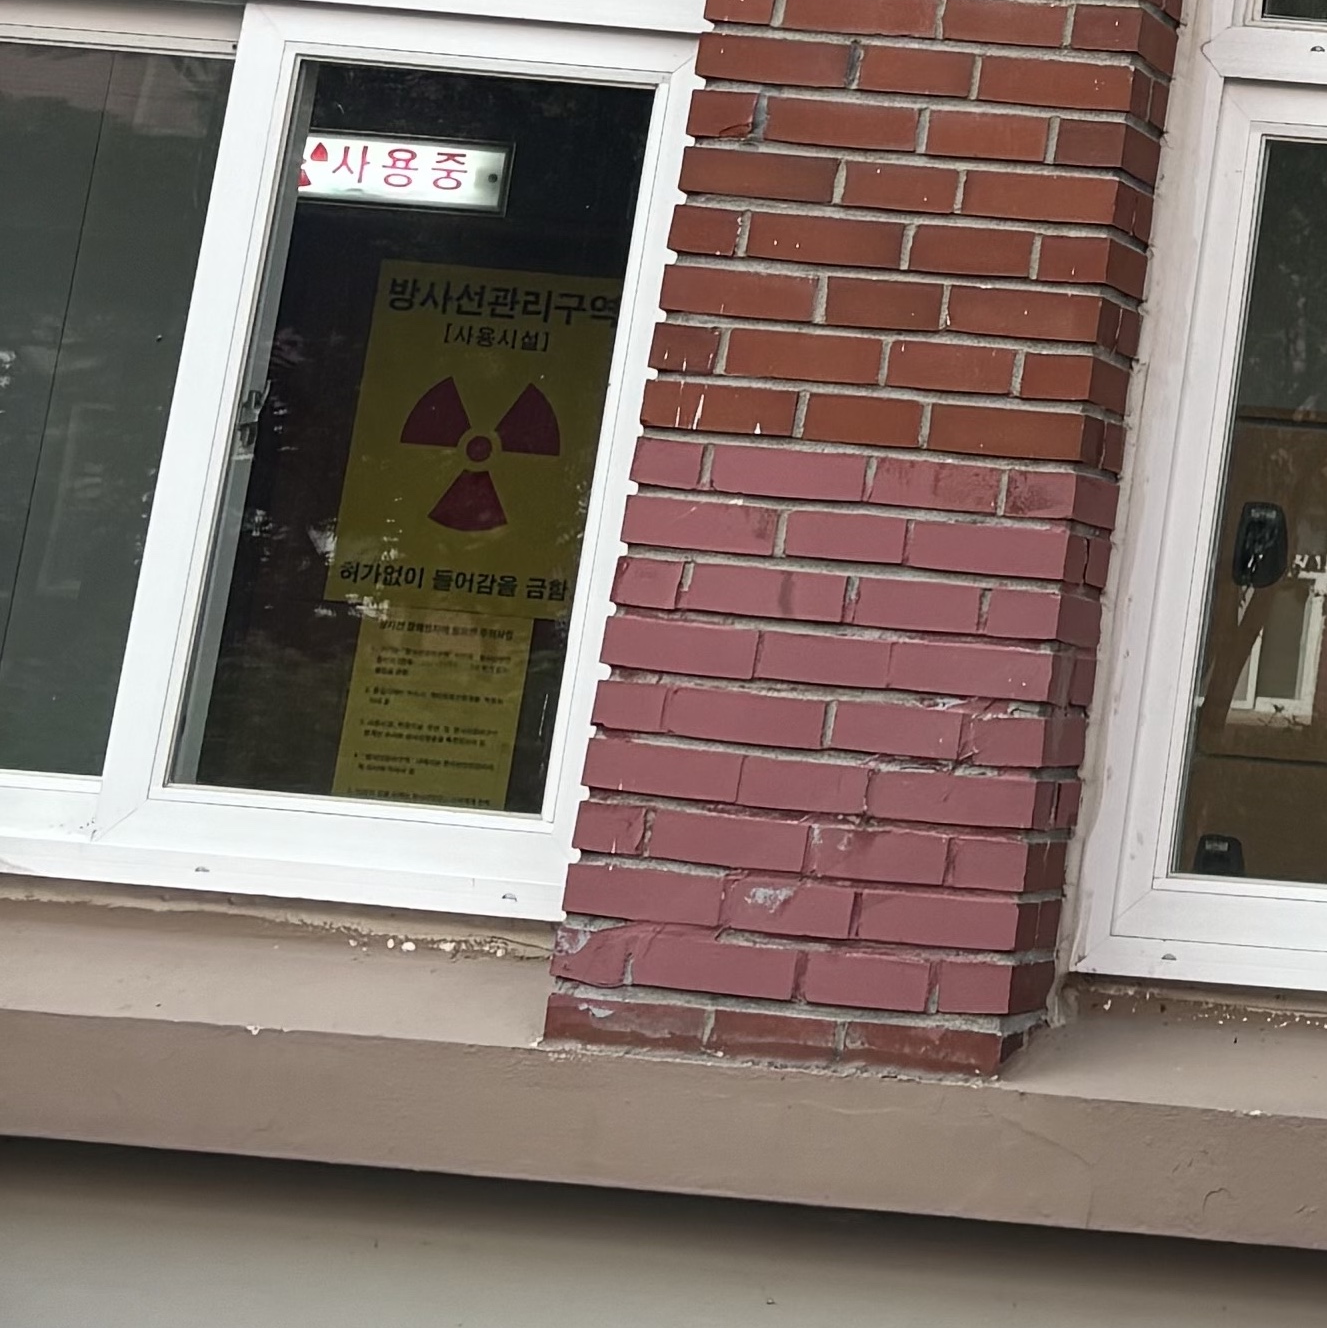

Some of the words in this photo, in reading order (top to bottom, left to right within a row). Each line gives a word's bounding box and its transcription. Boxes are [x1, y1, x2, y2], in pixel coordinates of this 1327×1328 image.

[332, 144, 468, 191] 사용중
[388, 277, 620, 329] 방사선관리구역
[340, 560, 424, 589] 허가없이
[433, 569, 518, 598] 들어감을
[526, 577, 569, 602] 금함
